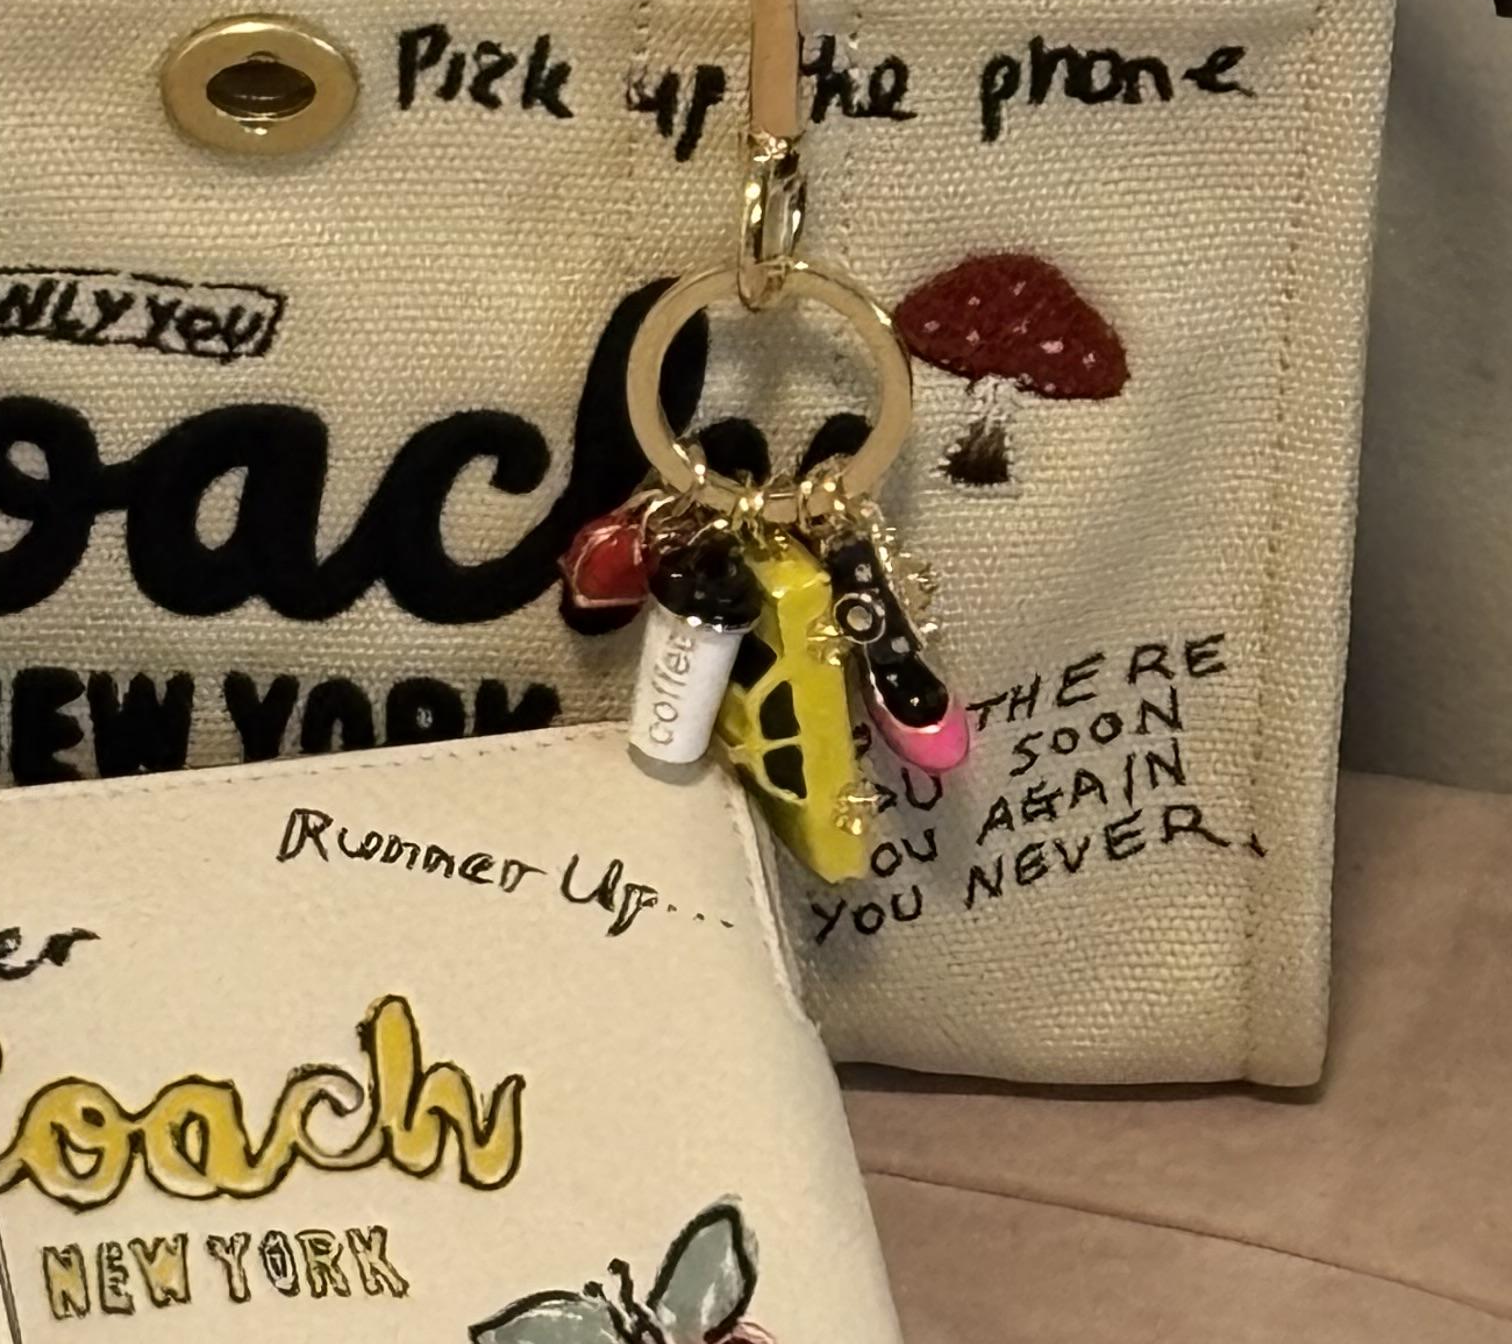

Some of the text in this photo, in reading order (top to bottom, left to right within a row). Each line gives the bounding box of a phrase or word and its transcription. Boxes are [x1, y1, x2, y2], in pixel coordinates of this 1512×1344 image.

[980, 34, 1258, 143] phone
[1009, 686, 1184, 778] SOON
[975, 737, 1187, 846] AGAIN
[811, 885, 924, 944] YOU
[43, 1225, 410, 1320] NEW YORK
